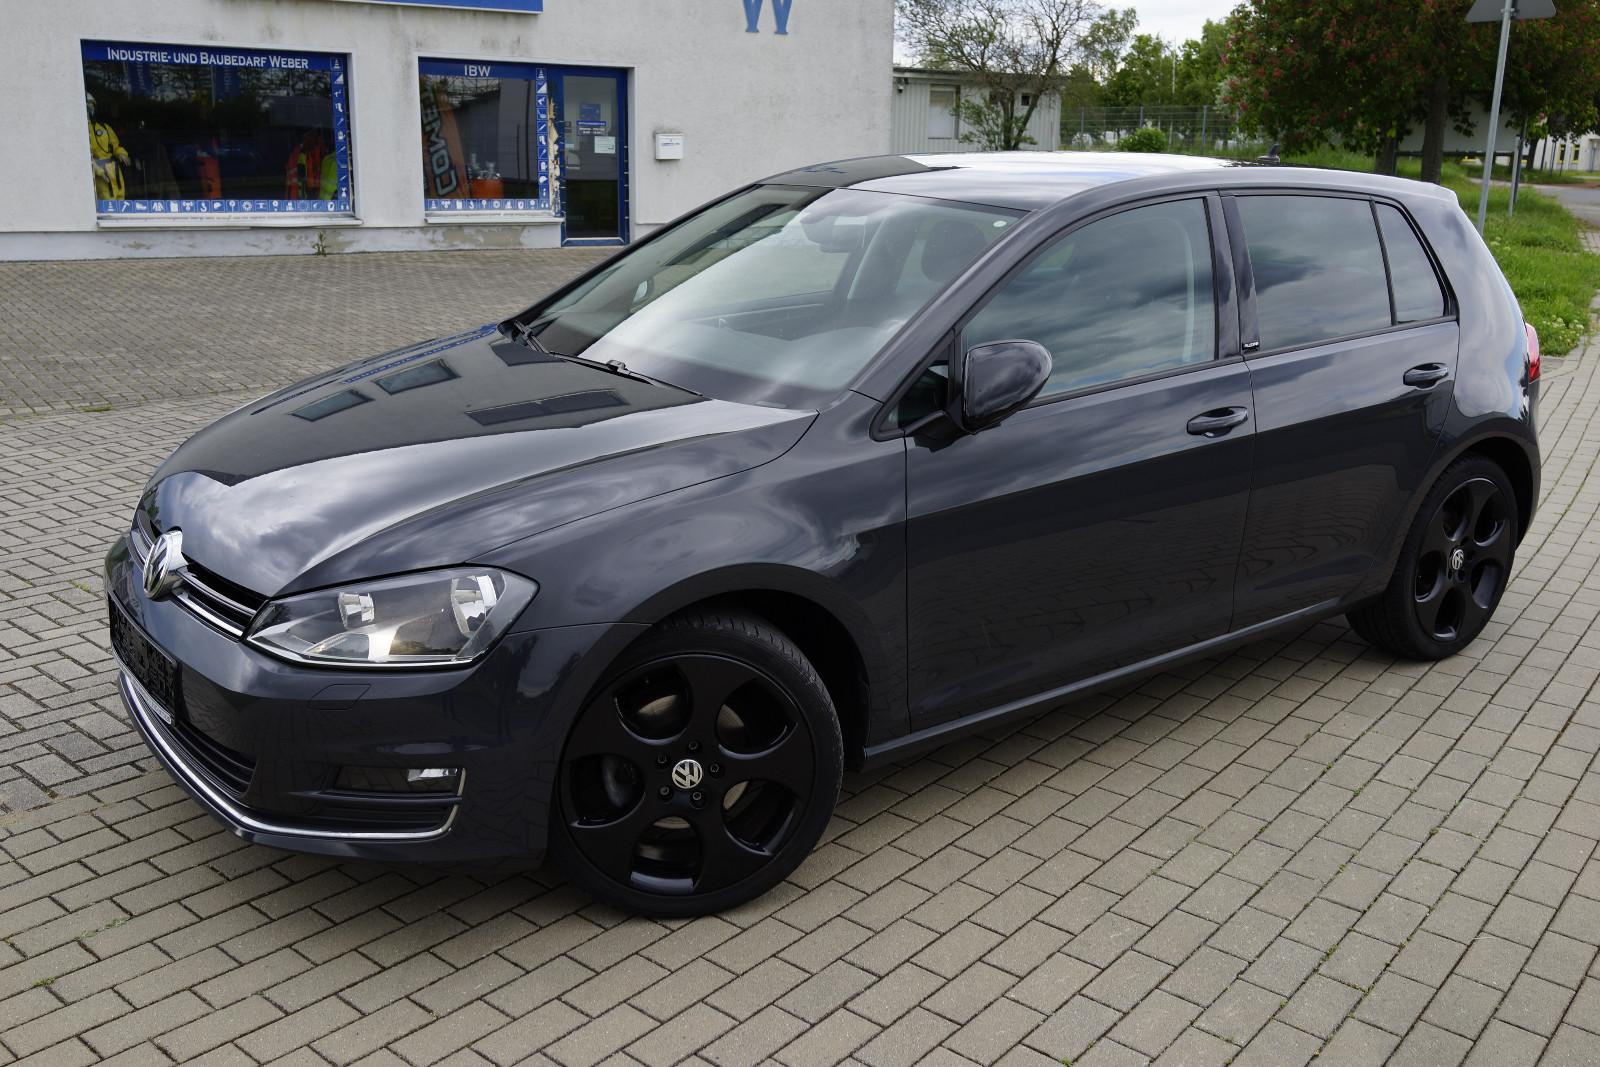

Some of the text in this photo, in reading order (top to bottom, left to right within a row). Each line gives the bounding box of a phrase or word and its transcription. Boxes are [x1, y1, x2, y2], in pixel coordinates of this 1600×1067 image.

[107, 47, 309, 69] INDUSTRIE- UND BAUBEDARF WEBER
[464, 64, 491, 77] IBW
[672, 759, 702, 789] VW
